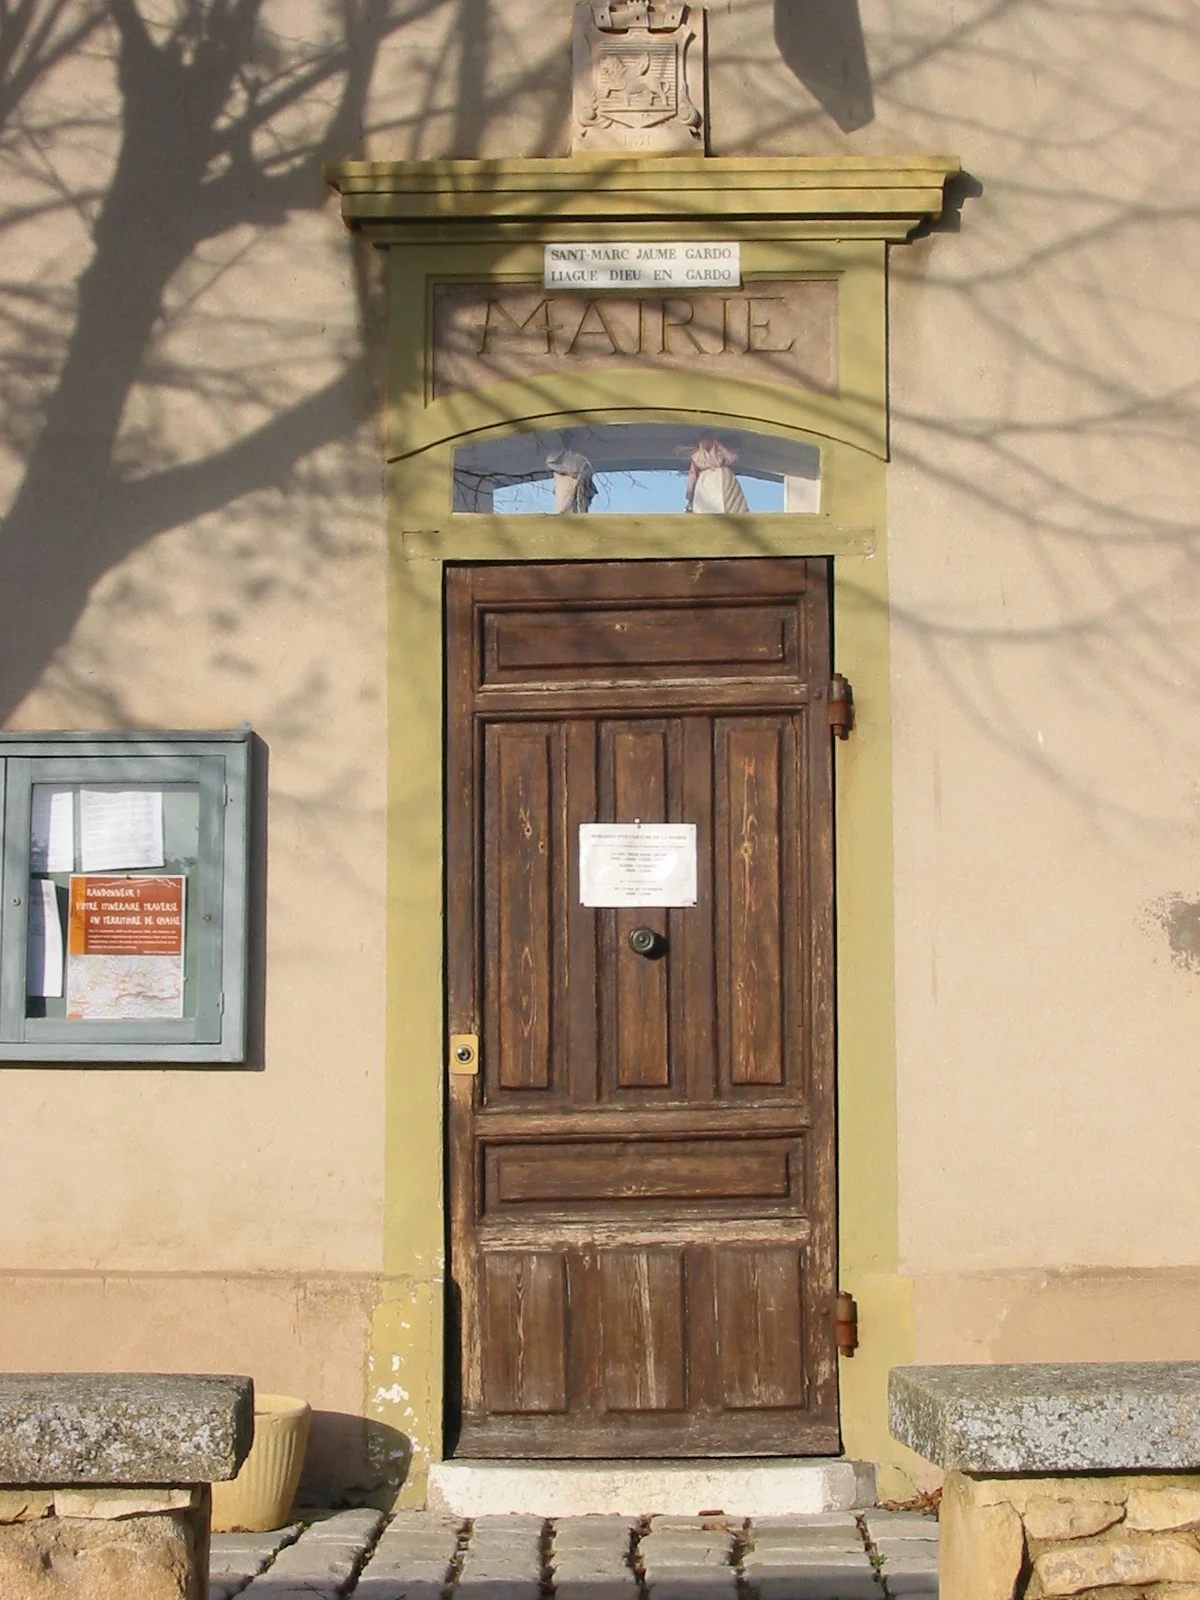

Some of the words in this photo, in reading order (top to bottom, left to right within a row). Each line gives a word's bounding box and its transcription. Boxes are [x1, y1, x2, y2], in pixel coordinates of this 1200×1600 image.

[550, 248, 630, 262] SANT-MARC
[636, 248, 677, 260] JAUME
[684, 247, 733, 260] GARDO
[550, 270, 599, 283] LIAGUE
[609, 269, 642, 282] DIEU
[653, 269, 673, 281] EN
[685, 269, 732, 281] GARDO
[476, 296, 797, 356] MAIRIE
[75, 901, 99, 911] VOTRE
[143, 901, 179, 912] TRAVERSE
[102, 915, 142, 926] TERRITOIRE
[144, 916, 155, 925] DE
[156, 916, 181, 926] CHASSE
